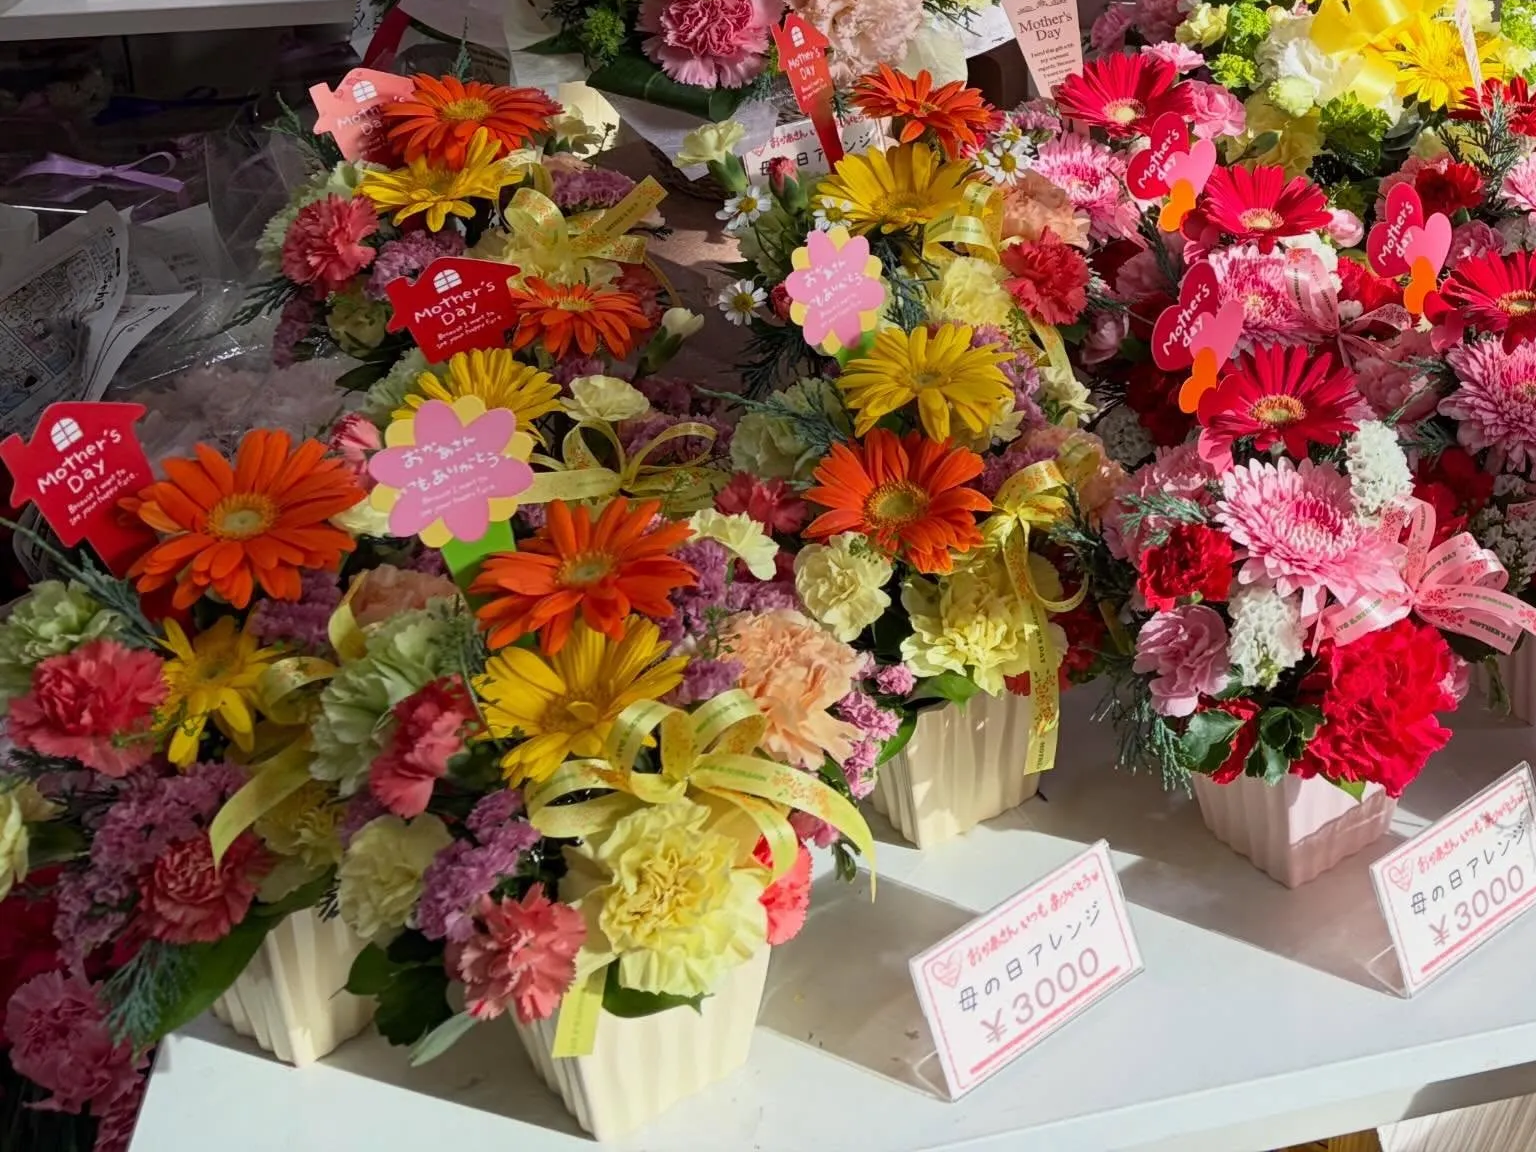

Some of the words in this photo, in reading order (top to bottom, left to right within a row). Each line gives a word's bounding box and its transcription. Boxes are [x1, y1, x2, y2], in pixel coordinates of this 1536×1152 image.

[1018, 12, 1073, 33] Mother's
[1036, 28, 1061, 41] Day
[788, 47, 821, 71] Mother's
[361, 118, 382, 136] Da
[1138, 130, 1180, 190] Mother's
[1157, 154, 1178, 180] day
[1378, 201, 1414, 266] Mother's
[1395, 232, 1414, 257] day
[414, 281, 495, 323] Mother's
[441, 302, 476, 325] Day
[1162, 283, 1210, 356] Mother's
[1182, 316, 1204, 348] day
[36, 428, 121, 495] Mother's
[67, 458, 105, 494] Day
[1410, 821, 1524, 915] 母の日アレンジ
[1429, 864, 1523, 947] ¥3000
[959, 901, 1100, 1012] 母の日アレンジ
[980, 947, 1098, 1044] ¥3000
